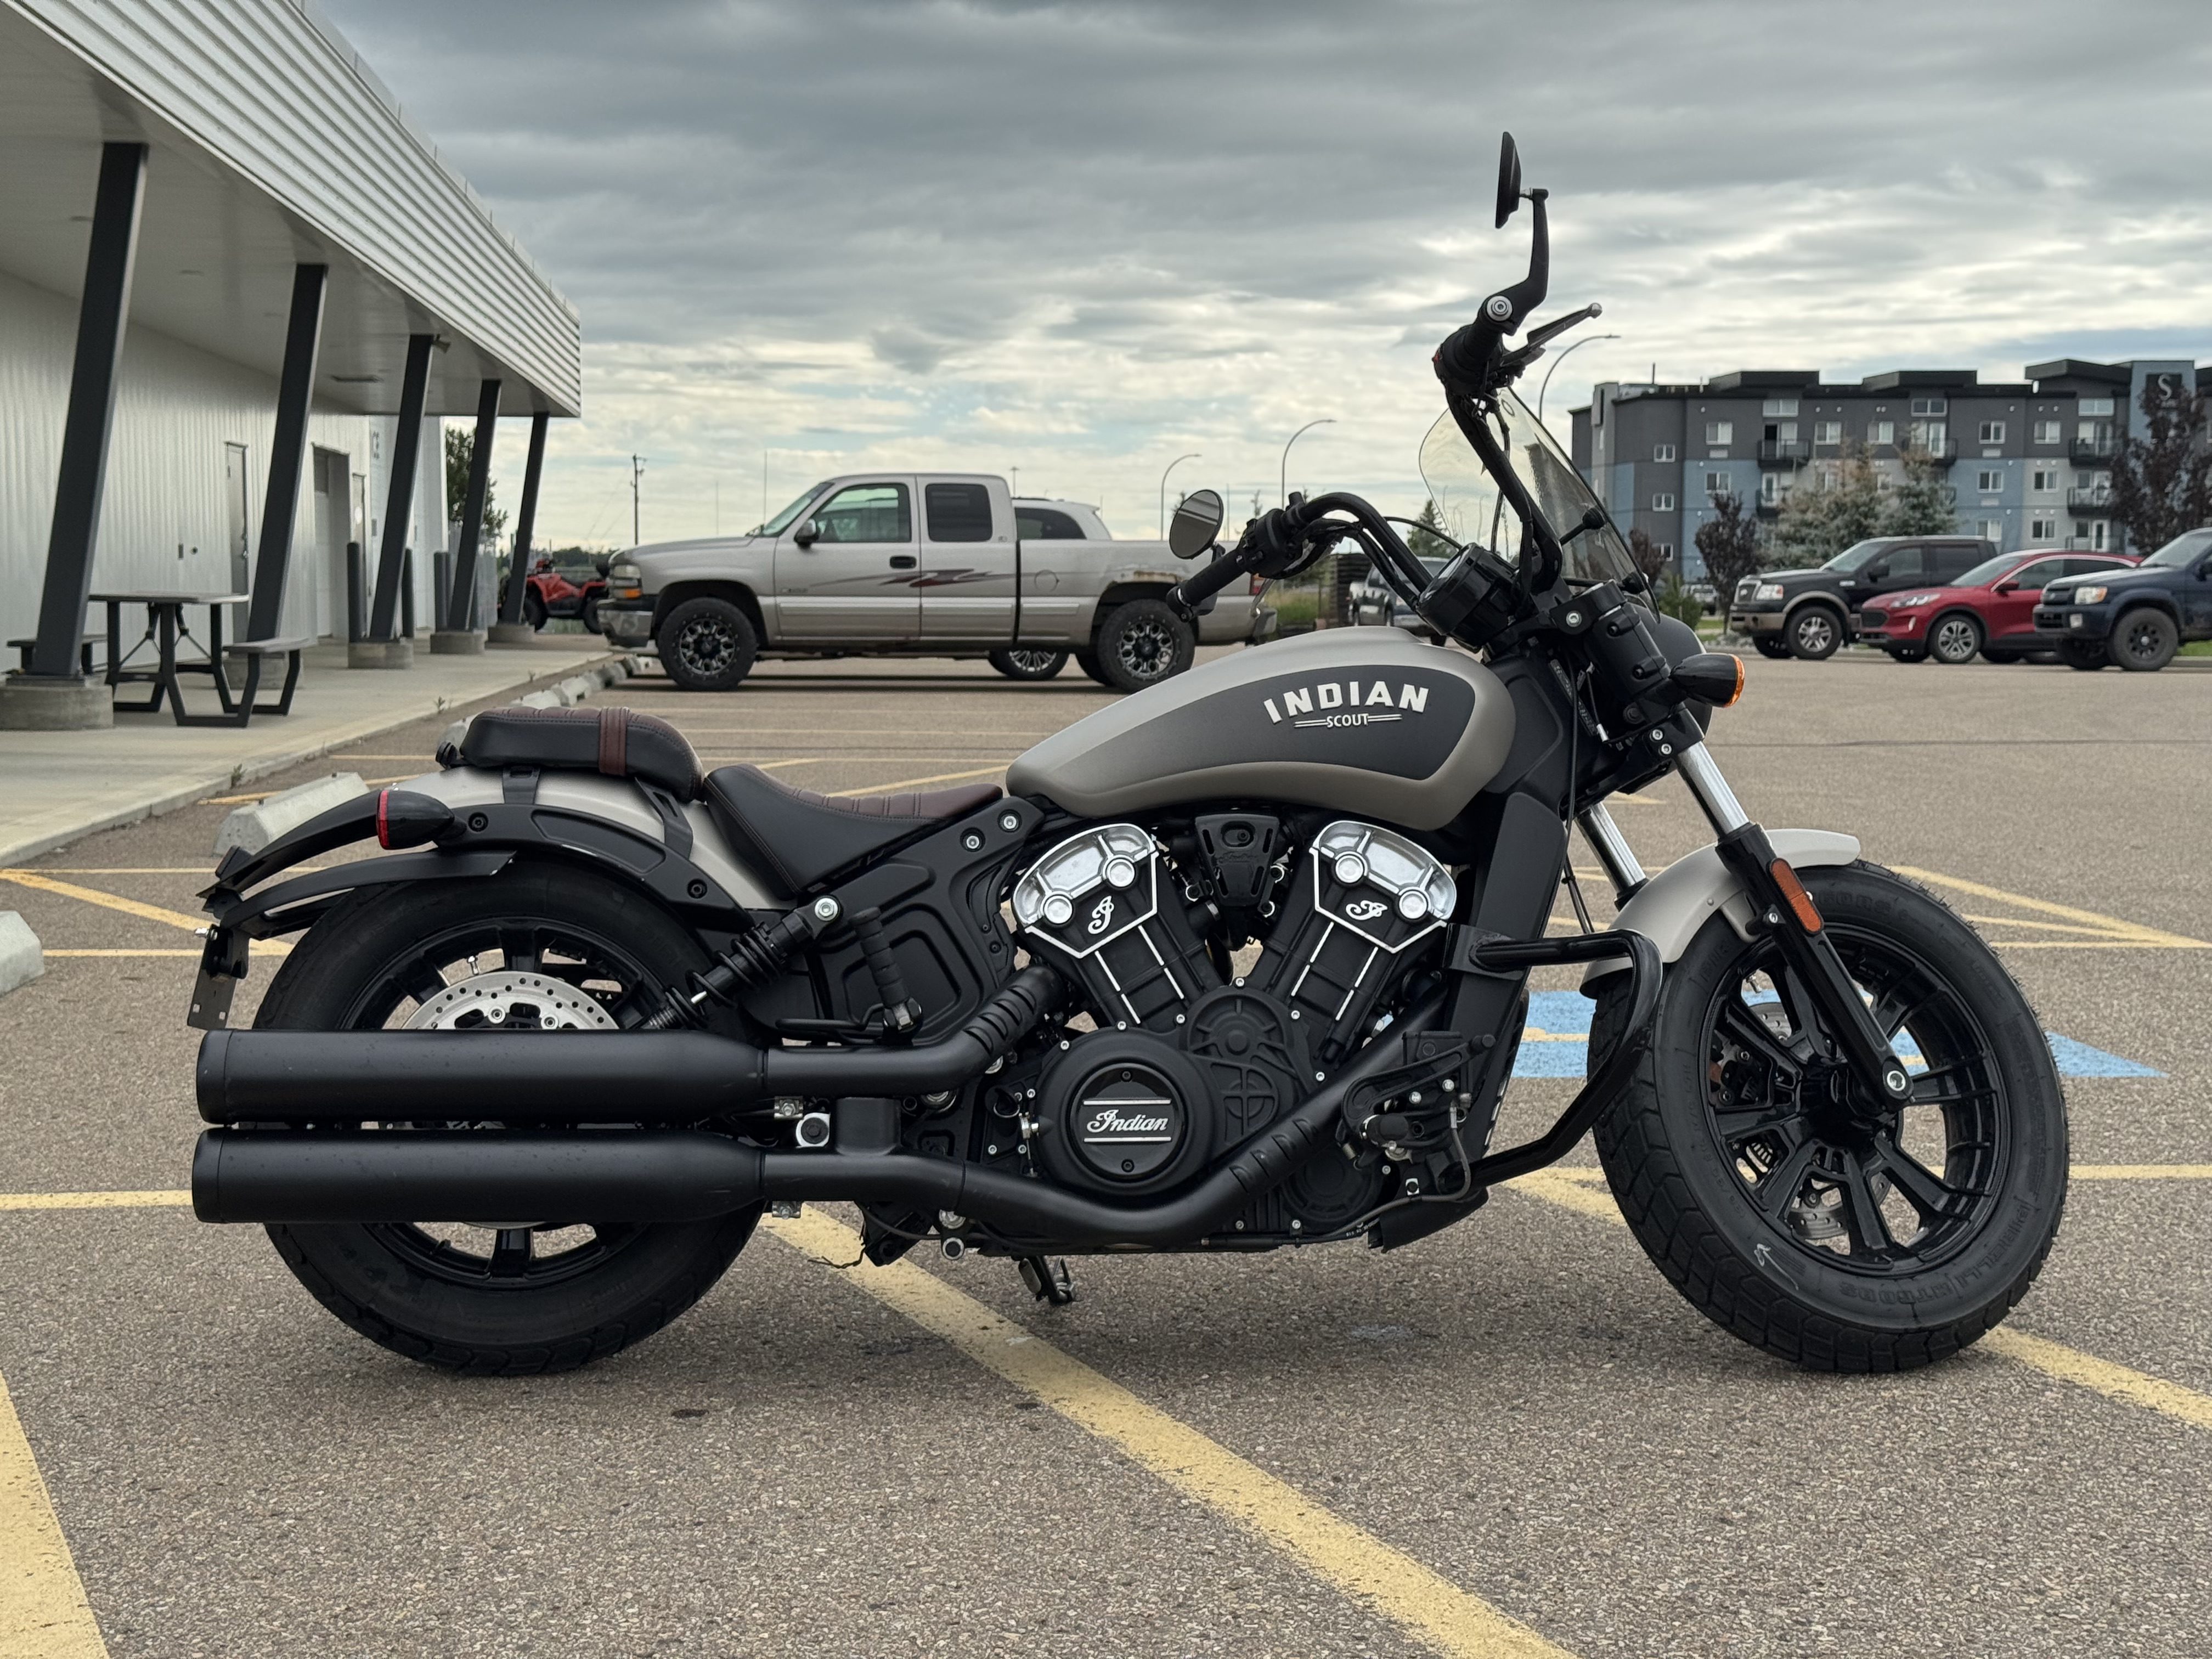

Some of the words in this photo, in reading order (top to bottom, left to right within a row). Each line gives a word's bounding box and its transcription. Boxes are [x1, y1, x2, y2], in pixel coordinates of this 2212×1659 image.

[1263, 680, 1429, 725] INDIAN
[1326, 713, 1369, 728] SCOUT
[1087, 1109, 1169, 1133] Indian
